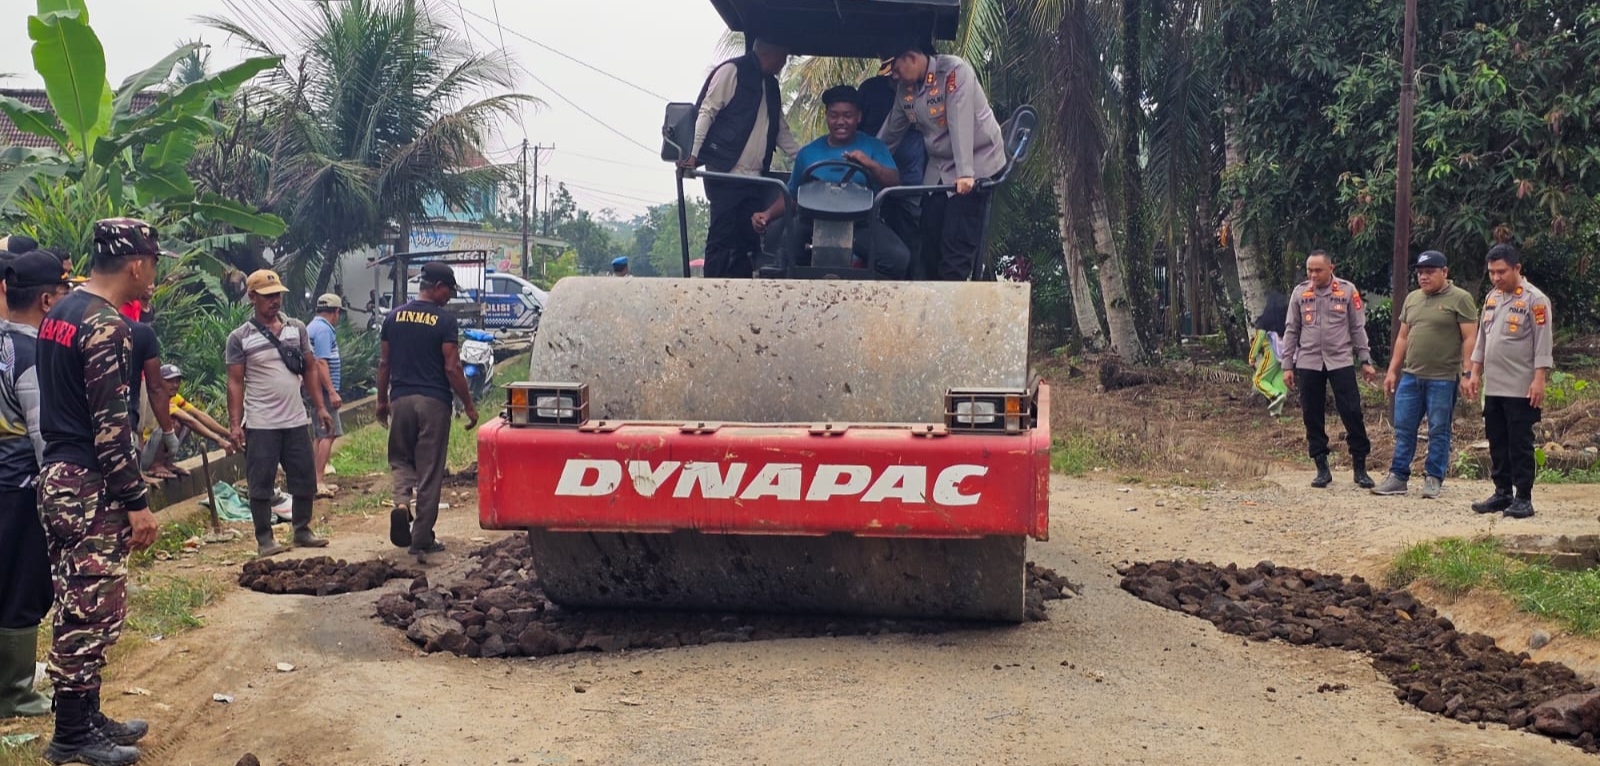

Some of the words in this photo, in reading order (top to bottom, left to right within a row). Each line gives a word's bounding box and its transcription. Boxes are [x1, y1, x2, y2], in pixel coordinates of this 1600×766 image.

[485, 303, 511, 313] OLISI
[396, 311, 438, 326] LINMAS
[554, 458, 989, 507] DYNAPAC
